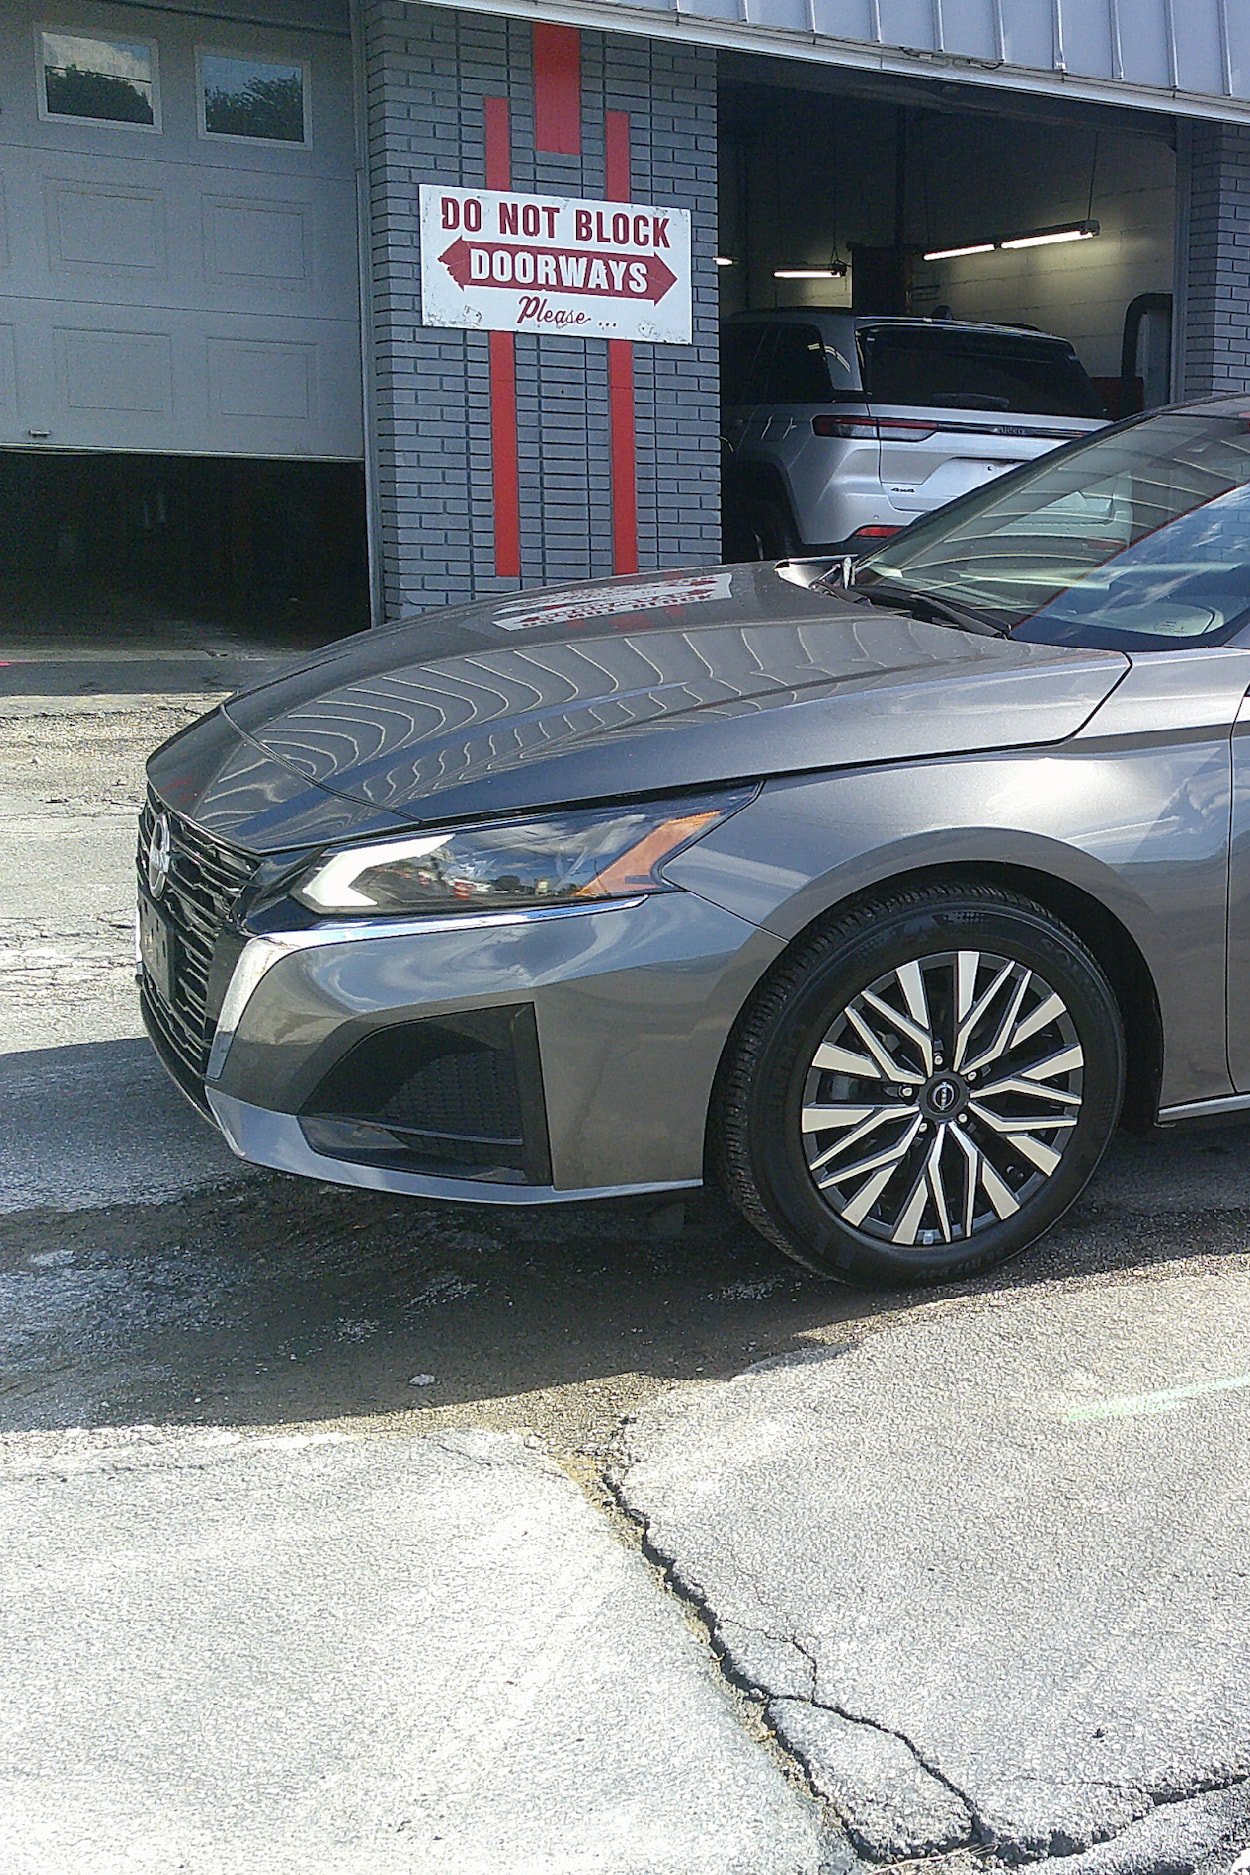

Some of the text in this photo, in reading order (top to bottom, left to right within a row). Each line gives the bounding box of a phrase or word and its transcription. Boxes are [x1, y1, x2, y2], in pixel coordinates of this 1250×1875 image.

[441, 197, 671, 249] DO NOT BLOCK
[469, 248, 649, 293] DOORWAYS
[516, 295, 592, 326] Please
